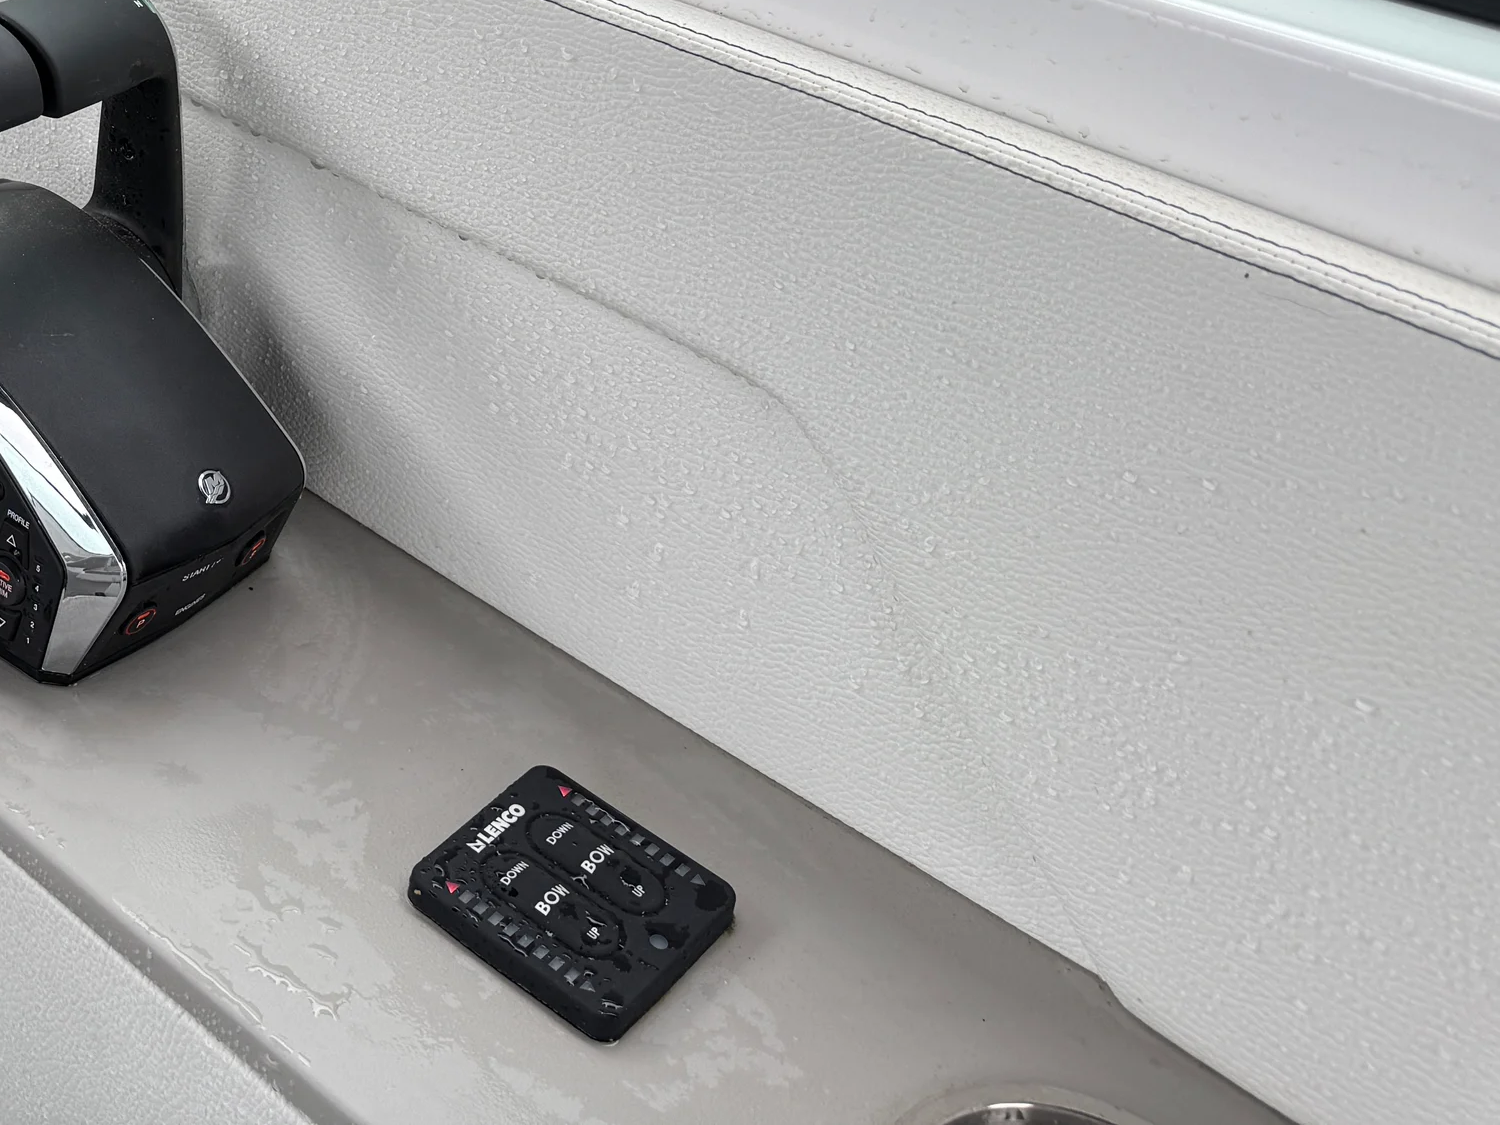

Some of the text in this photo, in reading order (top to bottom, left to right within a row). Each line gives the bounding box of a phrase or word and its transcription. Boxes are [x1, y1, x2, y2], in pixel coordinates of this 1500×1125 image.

[7, 508, 30, 530] PROFILE
[35, 564, 41, 573] 5
[34, 584, 40, 593] 4
[33, 603, 38, 611] 3
[30, 621, 35, 629] 2
[136, 619, 146, 629] P
[476, 803, 526, 842] LENCO
[546, 821, 574, 845] DOWN
[580, 843, 615, 874] BOW
[500, 860, 530, 886] DOWN
[631, 884, 646, 898] UP
[534, 883, 570, 916] BOW
[586, 926, 601, 940] UP
